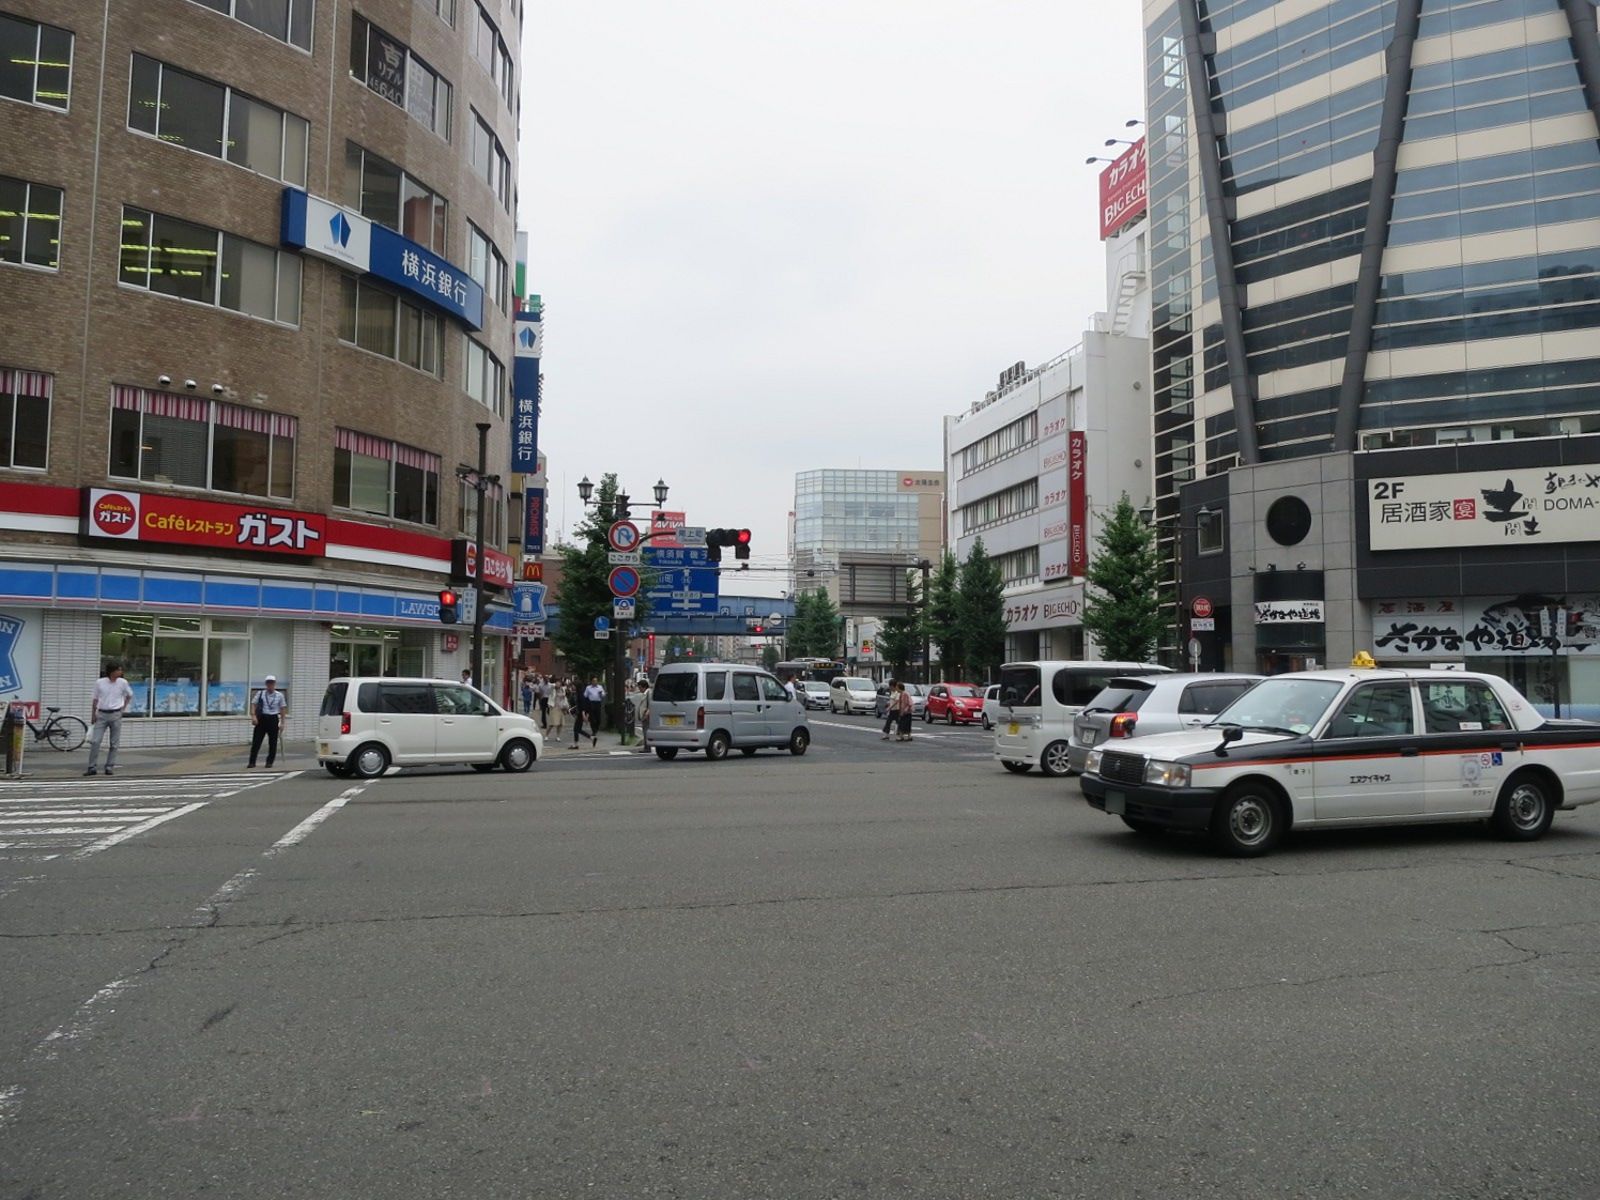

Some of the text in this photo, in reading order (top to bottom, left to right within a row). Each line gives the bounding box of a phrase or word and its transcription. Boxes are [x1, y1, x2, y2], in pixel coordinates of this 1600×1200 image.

[1105, 196, 1124, 227] BIG
[1126, 180, 1145, 205] ECH
[402, 249, 467, 306] 横浜銀行
[517, 399, 534, 461] 横浜銀行
[1044, 417, 1066, 435] カラオケ
[1072, 438, 1082, 480] カラオケ
[1044, 490, 1066, 505] カラオケ
[1374, 482, 1404, 499] 2F
[99, 511, 131, 523] ガスト
[1381, 500, 1451, 524] 居酒家
[237, 513, 319, 549] ガスト
[609, 553, 639, 562] ここから
[483, 557, 506, 578] 口こちら
[1045, 563, 1068, 577] カラオケ
[401, 601, 441, 617] LAWSO
[1006, 604, 1038, 624] カラオケ
[1044, 600, 1077, 618] BIG ECHO
